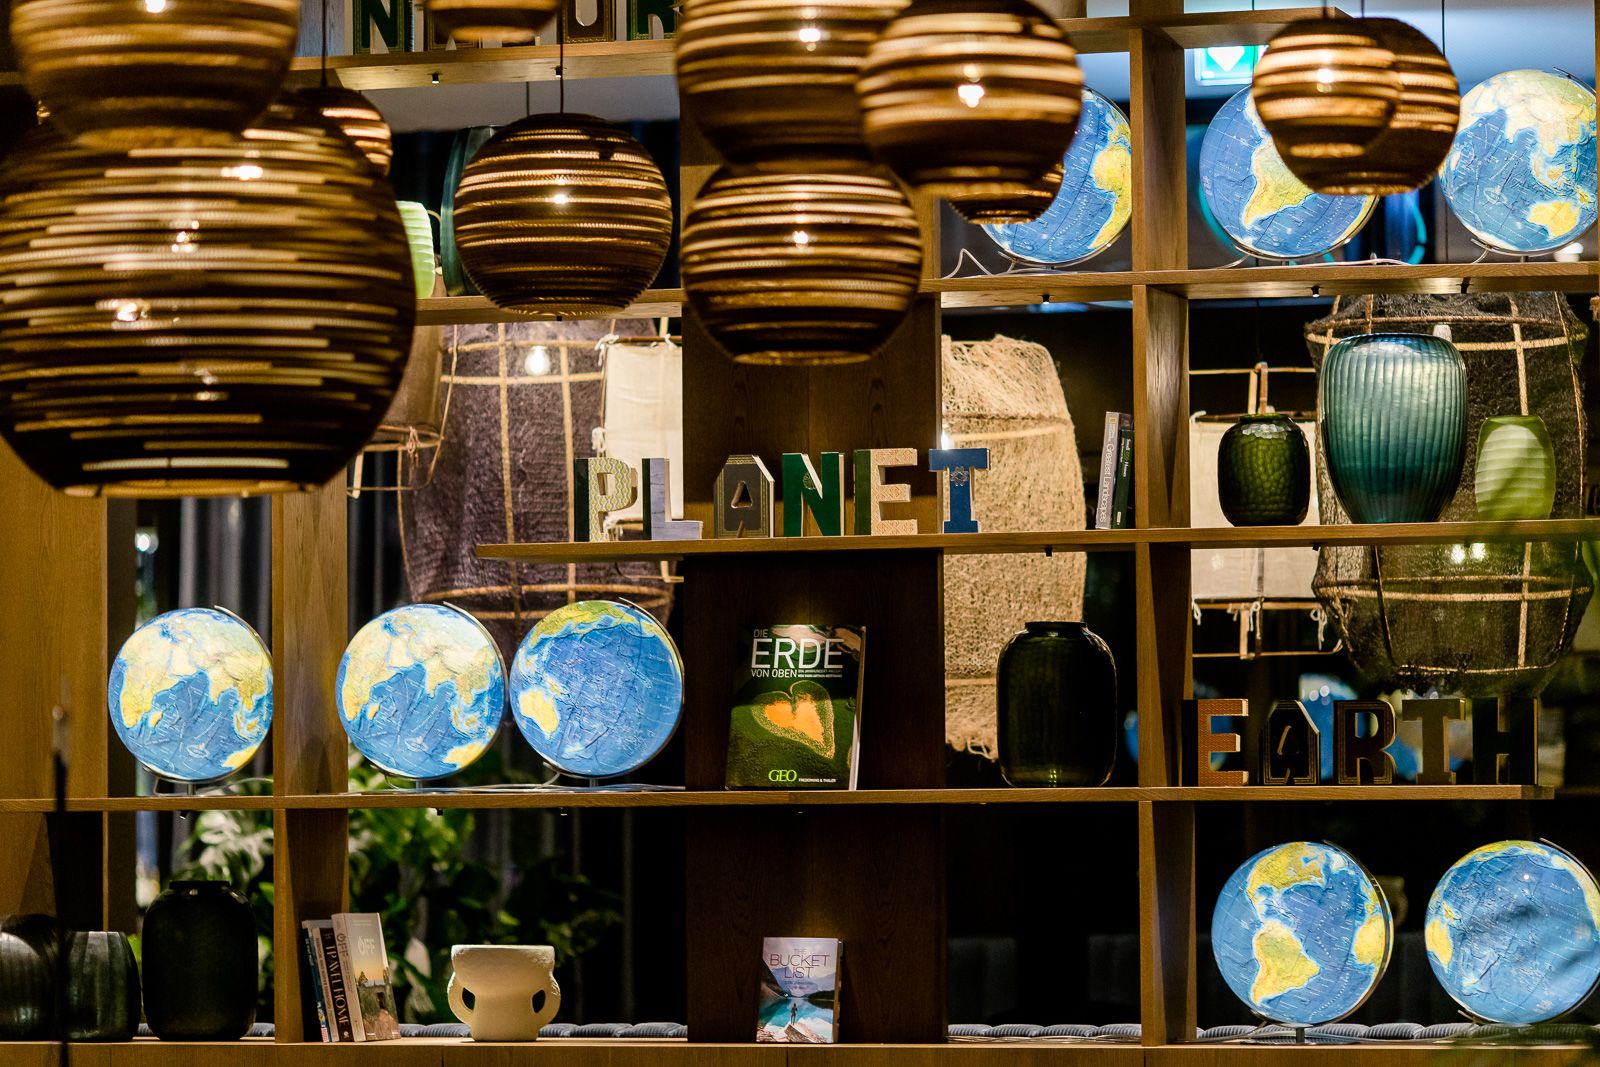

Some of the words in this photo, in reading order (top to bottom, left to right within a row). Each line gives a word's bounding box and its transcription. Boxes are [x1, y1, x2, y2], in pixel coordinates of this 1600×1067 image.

[1104, 444, 1115, 475] Greatest
[574, 447, 990, 542] PLANET
[1100, 476, 1111, 523] Landscapes
[753, 628, 769, 638] DIE
[751, 638, 844, 669] ERDE
[751, 669, 770, 678] VON
[771, 669, 797, 678] OBEN
[1183, 698, 1538, 786] EARTH
[768, 769, 797, 782] GEO
[325, 944, 342, 985] TRAVEL
[769, 954, 830, 966] BUCKET
[784, 966, 813, 979] LIST
[333, 987, 350, 1025] HOME
